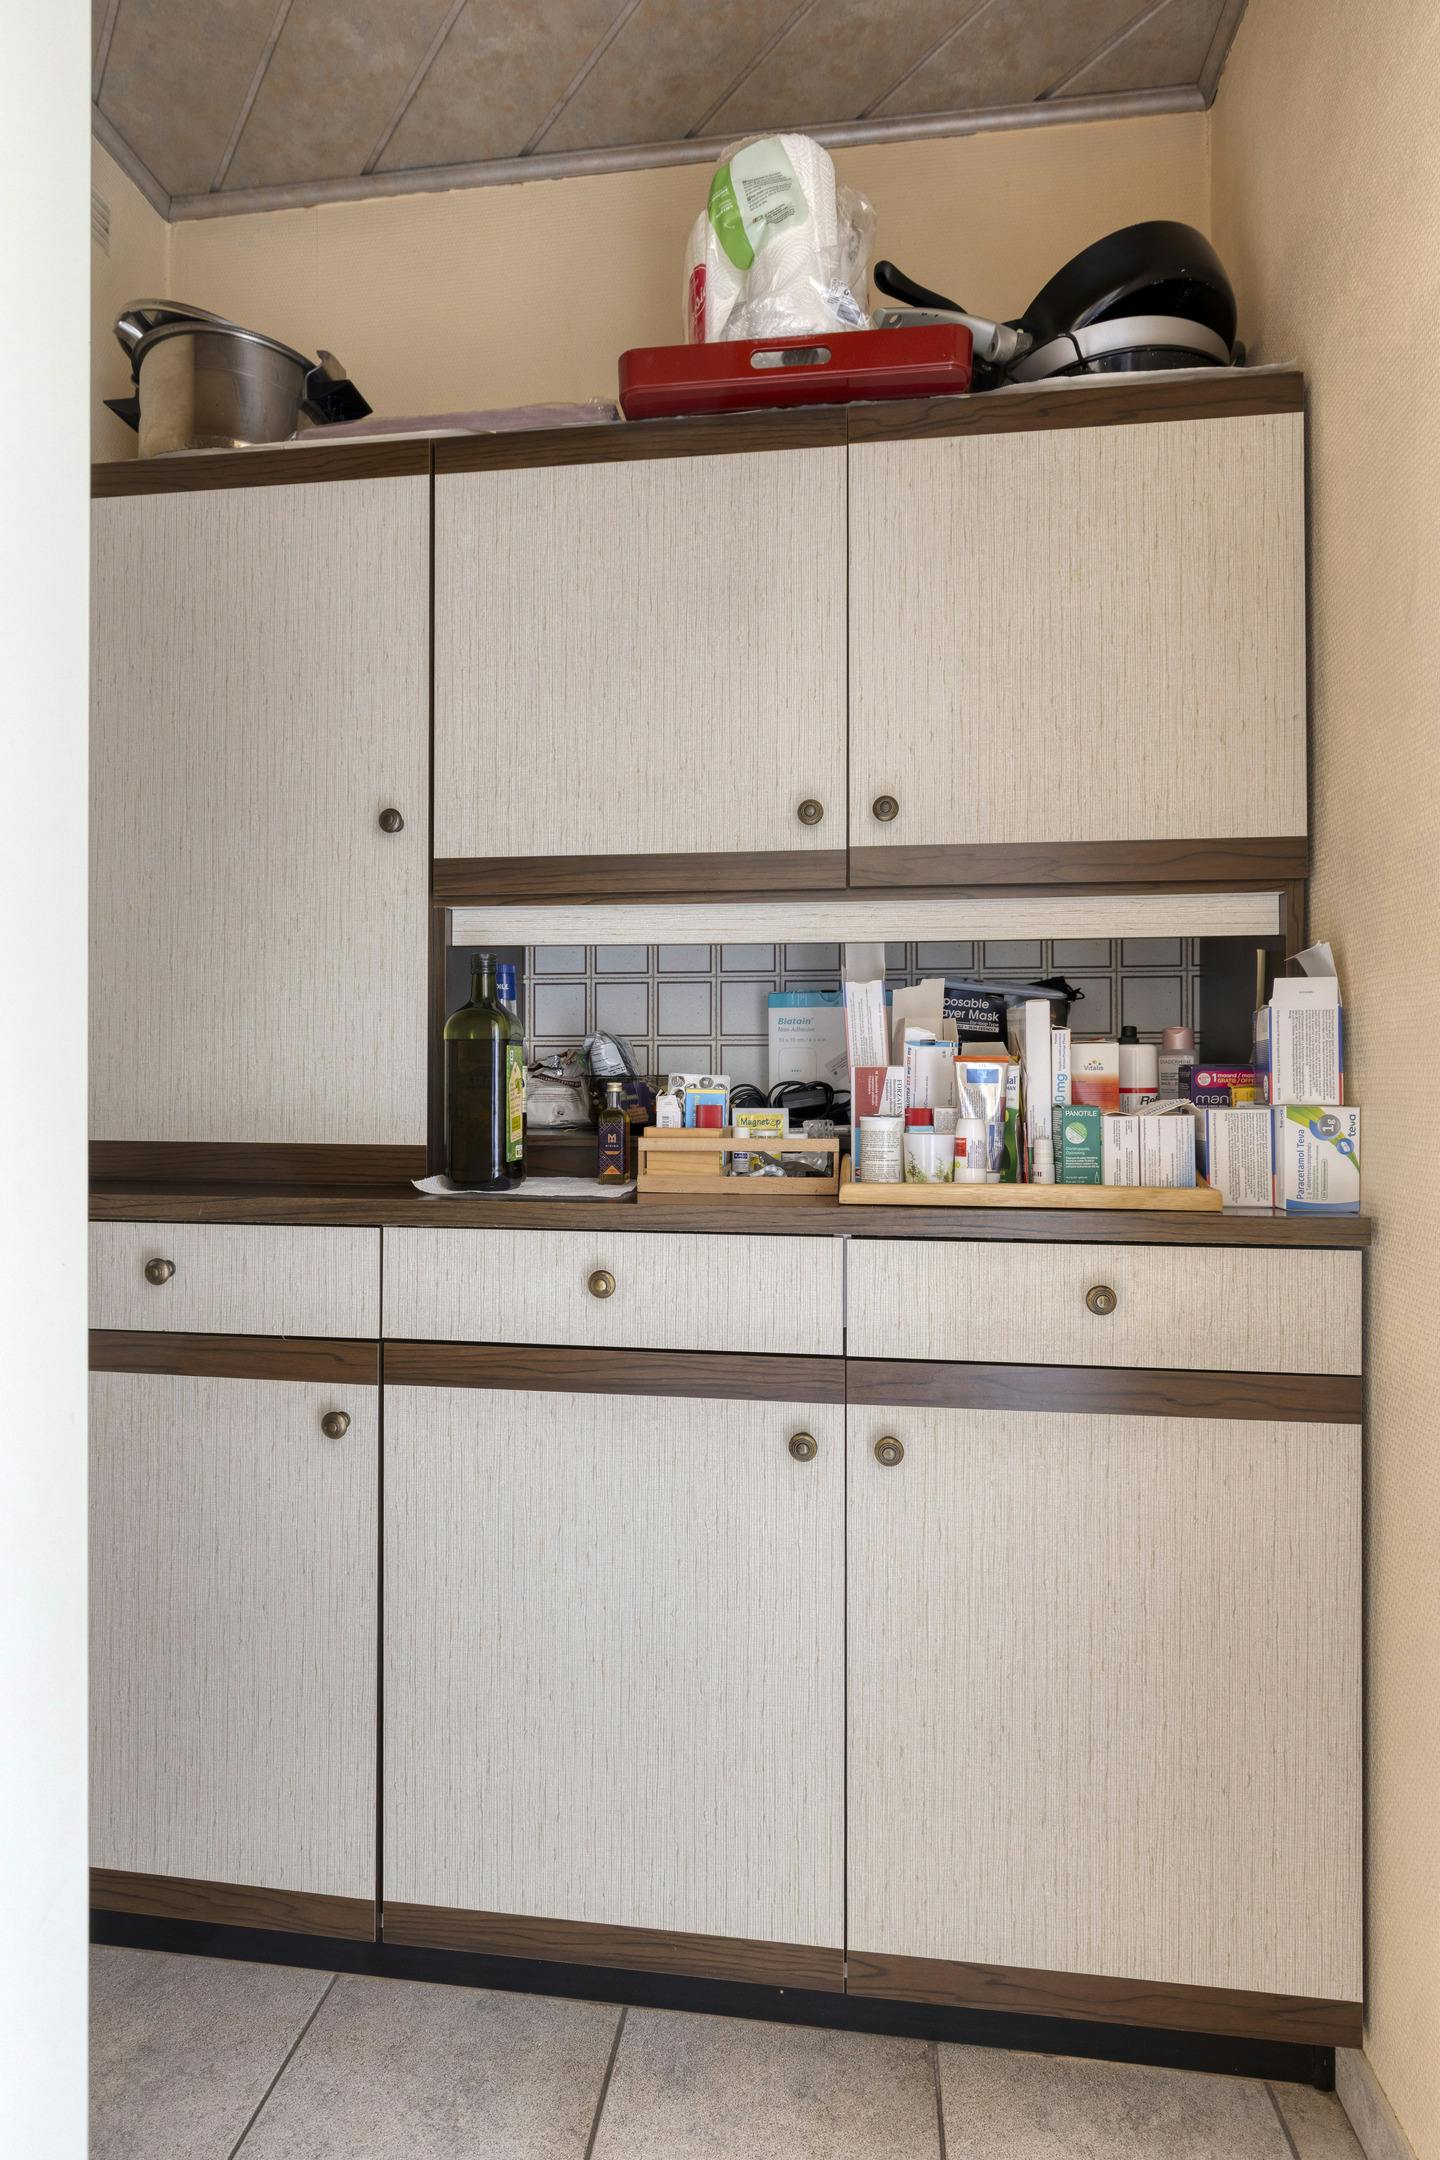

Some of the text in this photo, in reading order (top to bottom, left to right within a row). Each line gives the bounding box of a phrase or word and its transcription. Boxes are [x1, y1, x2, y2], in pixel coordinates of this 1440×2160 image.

[968, 1008, 1000, 1022] Mask
[1083, 1063, 1104, 1071] Vitalis
[1056, 1073, 1068, 1093] mg
[1211, 1073, 1217, 1083] 1
[1347, 1114, 1357, 1137] teva
[1296, 1129, 1305, 1200] Paracetamol Teva
